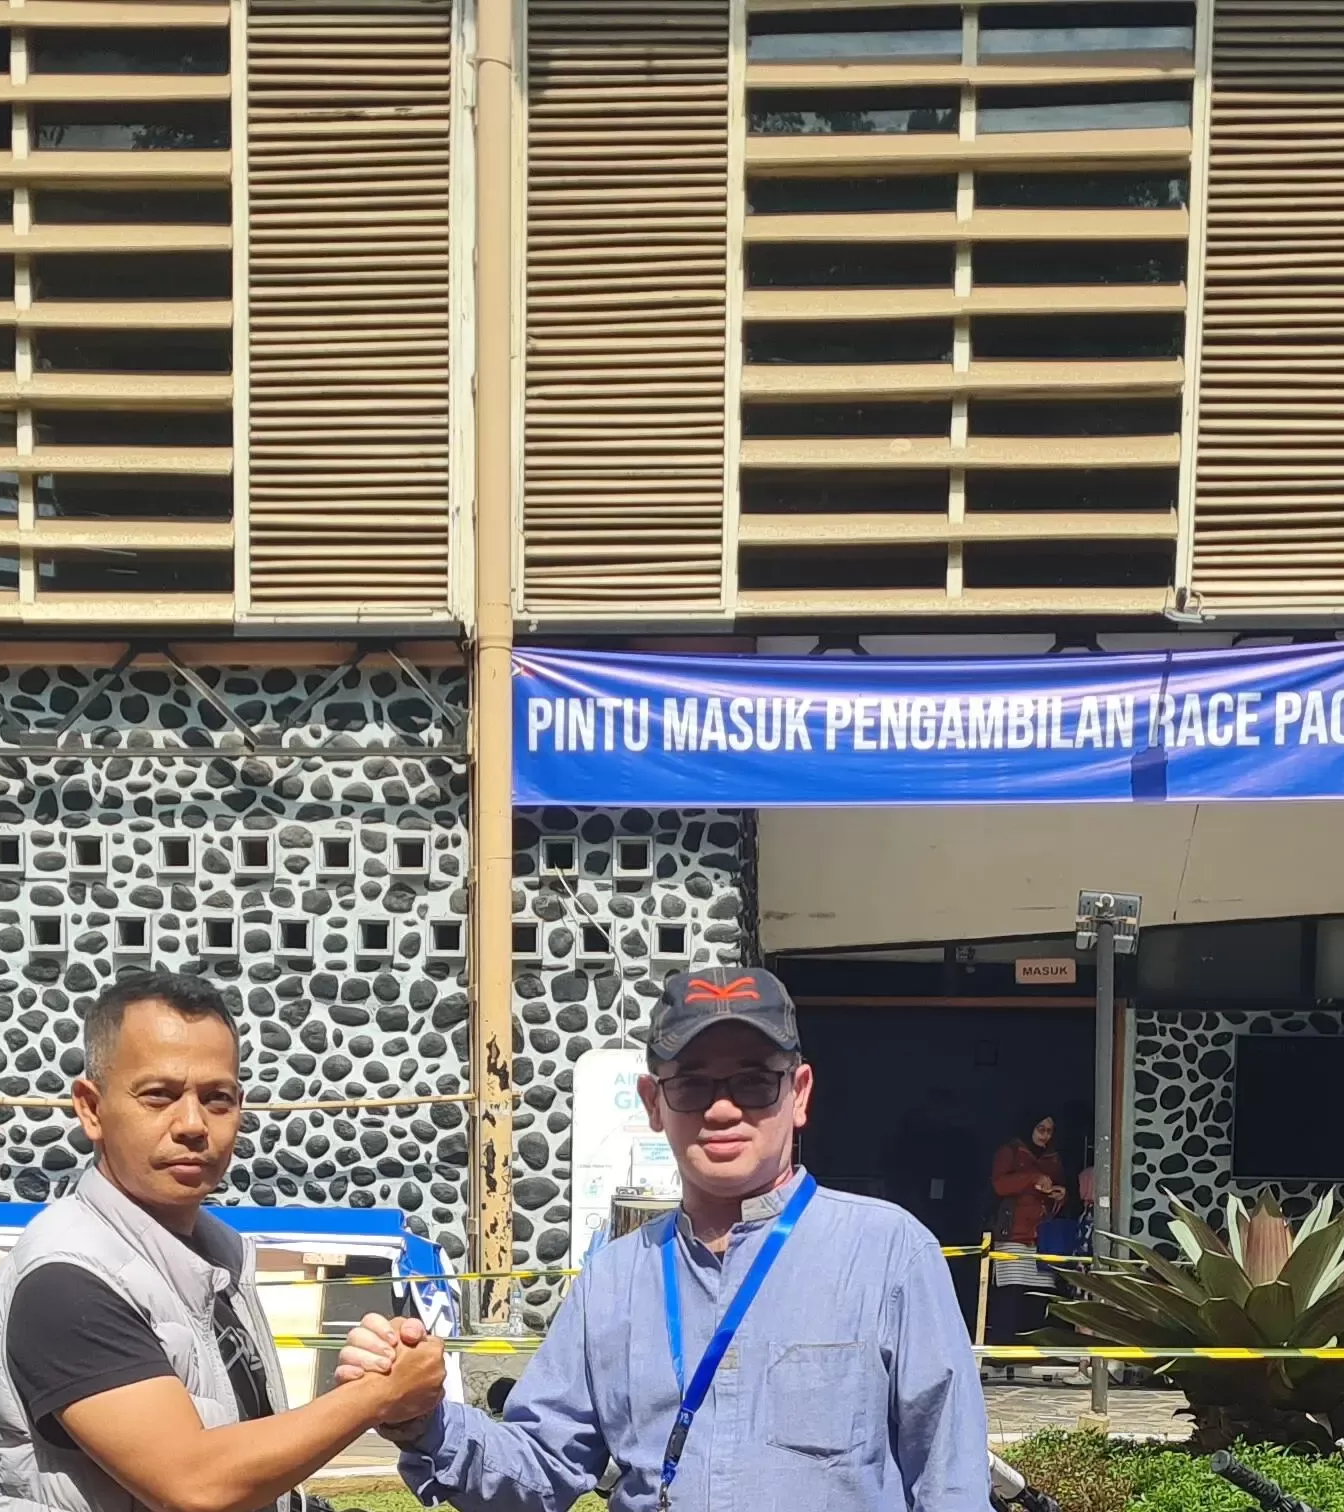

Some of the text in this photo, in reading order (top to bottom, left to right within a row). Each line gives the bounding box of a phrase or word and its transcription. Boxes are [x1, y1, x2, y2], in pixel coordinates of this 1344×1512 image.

[528, 697, 649, 752] PINTU
[663, 697, 813, 752] MASUK
[826, 695, 1136, 752] PENGAMBILAN
[1148, 692, 1262, 748] RACE
[1022, 966, 1068, 976] MASUK
